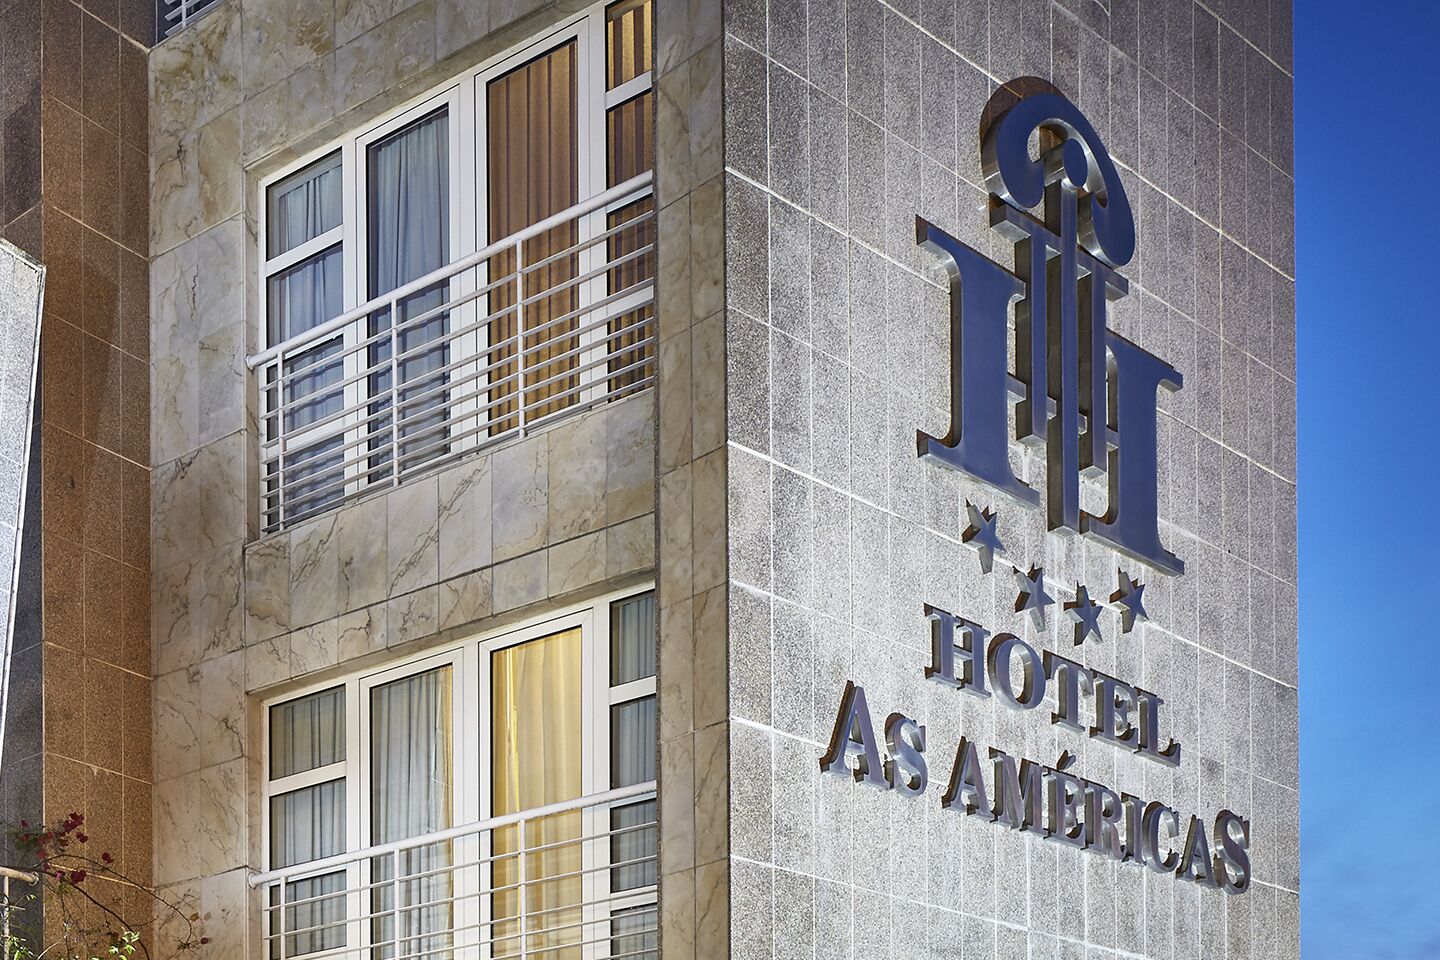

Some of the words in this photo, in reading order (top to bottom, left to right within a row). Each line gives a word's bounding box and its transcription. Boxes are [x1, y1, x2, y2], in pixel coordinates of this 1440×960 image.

[923, 602, 1180, 768] HOTEL
[819, 680, 926, 798] AS
[941, 735, 1251, 896] AMÉRICAS
